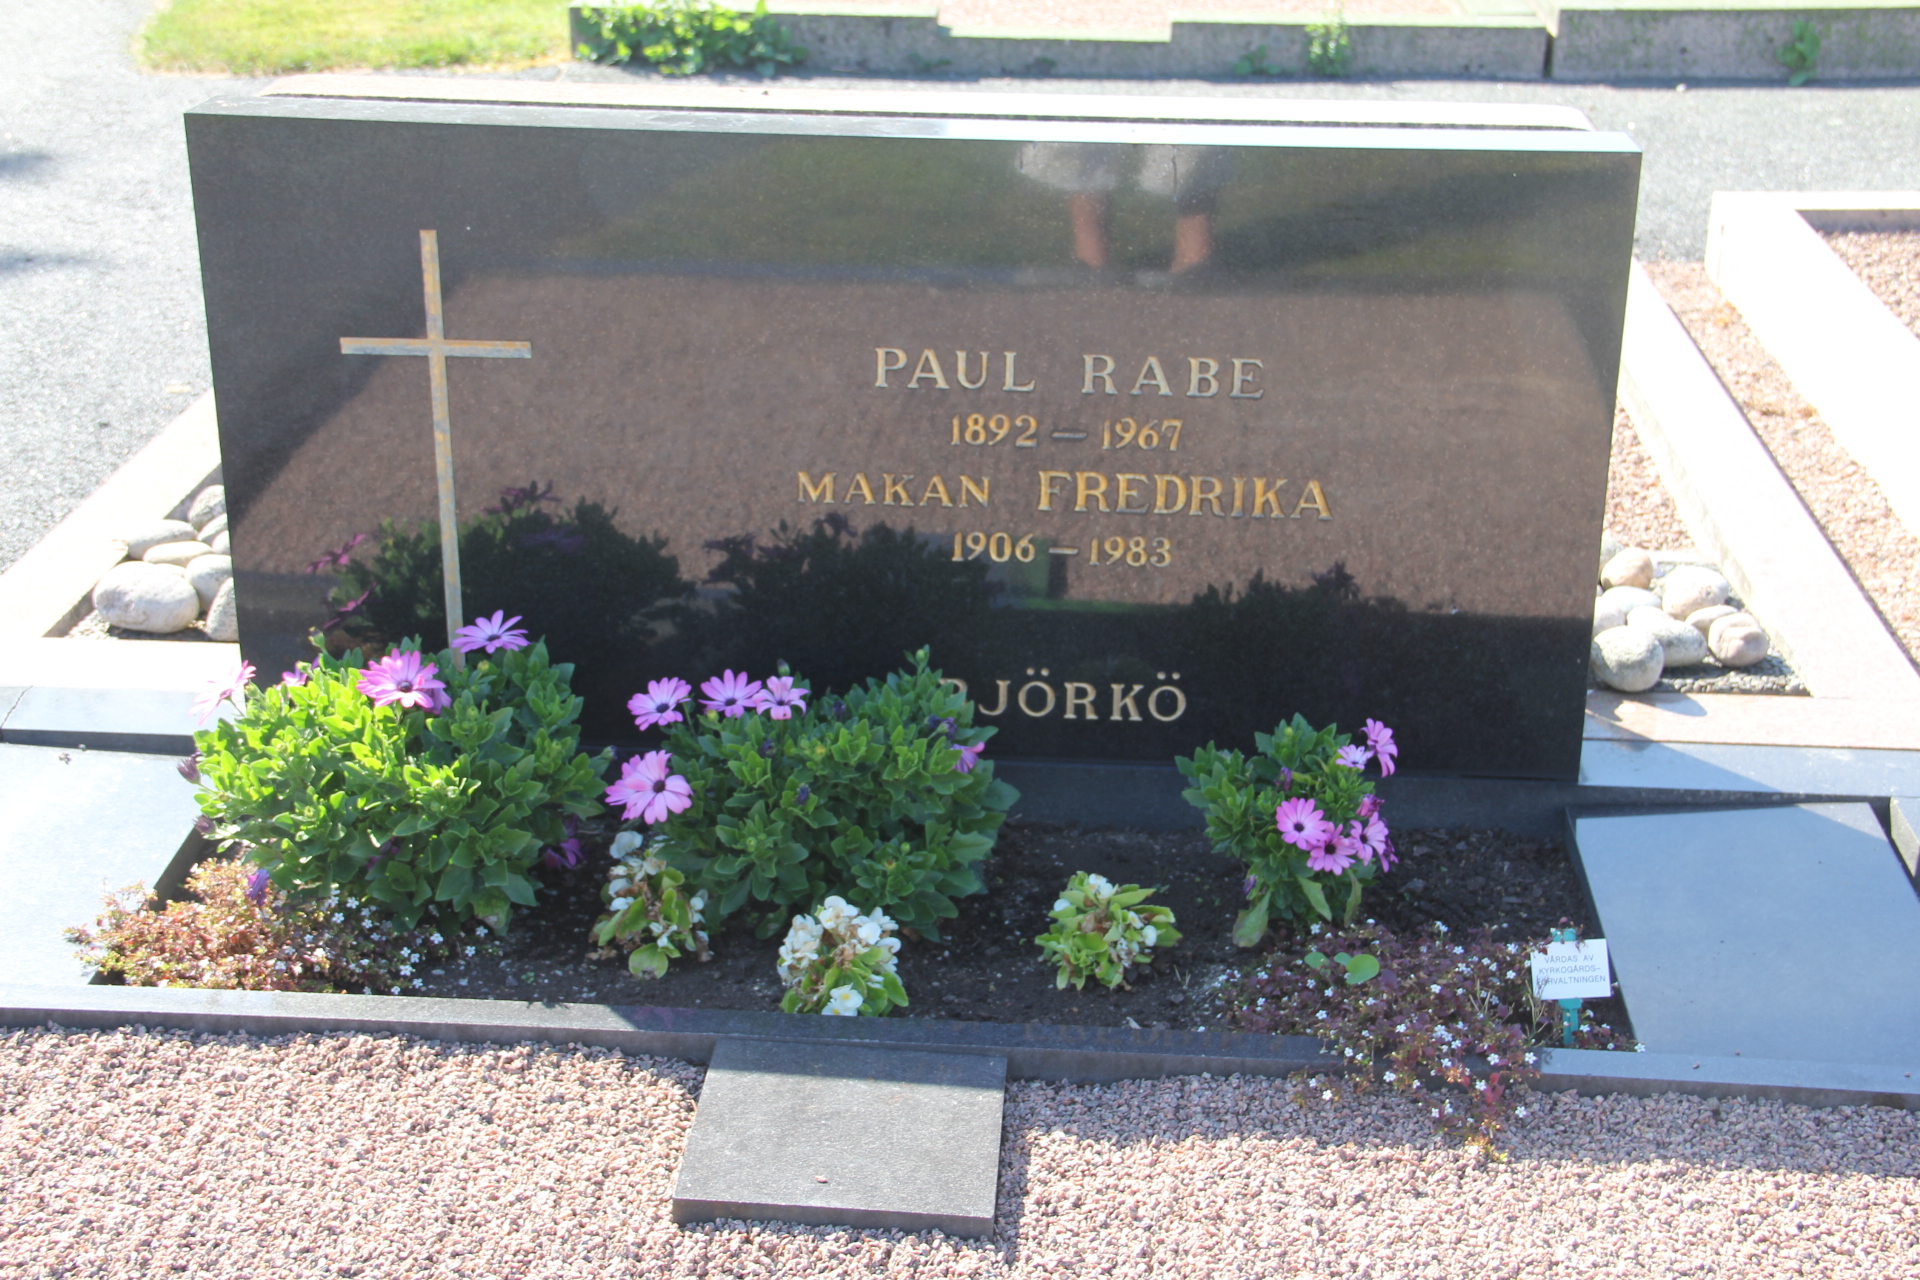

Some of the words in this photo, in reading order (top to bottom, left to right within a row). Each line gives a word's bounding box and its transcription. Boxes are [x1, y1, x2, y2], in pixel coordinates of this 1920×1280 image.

[874, 347, 1036, 392] PAUL
[1081, 353, 1265, 399] RABE
[951, 413, 1038, 448] 1892
[1101, 417, 1184, 452] 1967
[797, 471, 990, 508] MAKAN
[1037, 470, 1333, 521] FREDRIKA
[951, 532, 1036, 563] 1906
[1088, 536, 1172, 567] 1983
[1539, 965, 1601, 974] KYRKOGÅRDS-
[1544, 955, 1578, 963] VÅRDAS
[1583, 954, 1594, 962] AV
